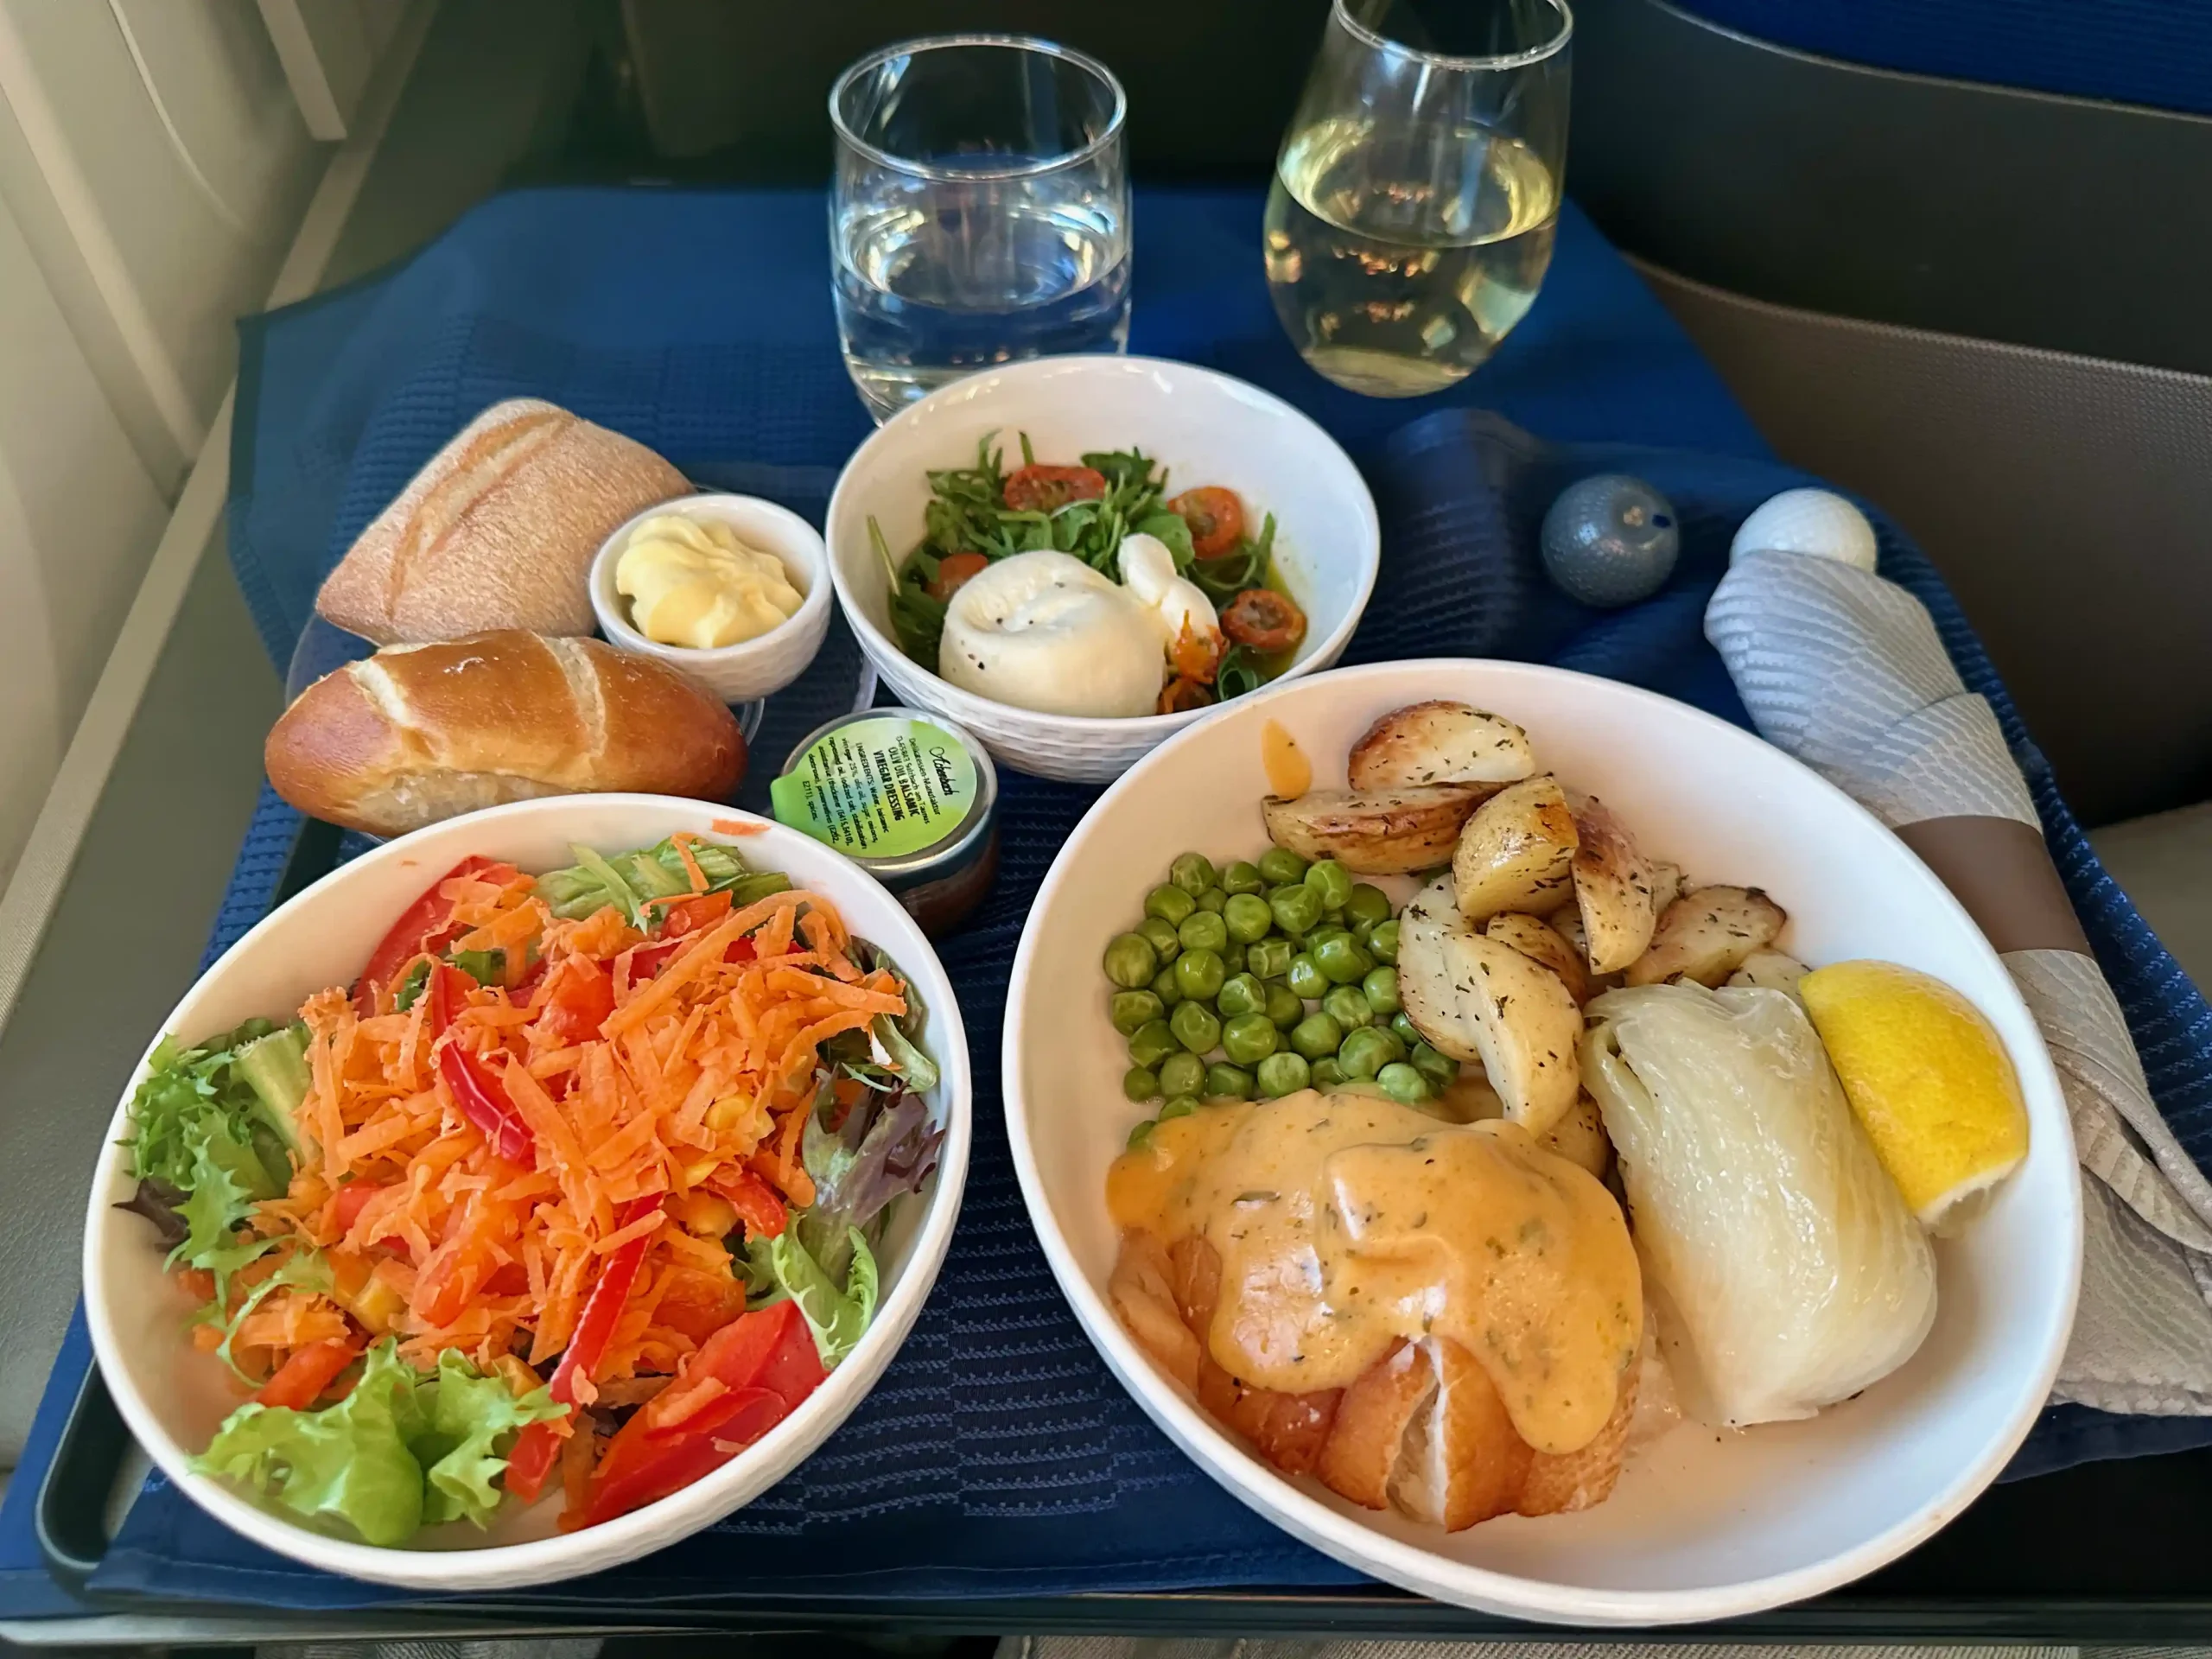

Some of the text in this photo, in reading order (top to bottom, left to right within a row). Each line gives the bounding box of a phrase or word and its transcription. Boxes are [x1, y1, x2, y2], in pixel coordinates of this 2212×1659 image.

[873, 749, 906, 822] VINEGAR DRESSING
[887, 746, 921, 817] OLIV OIL BALSAMIC
[928, 746, 961, 797] Achenbach
[914, 791, 923, 802] am
[918, 801, 931, 825] Taunus
[875, 807, 890, 834] balsamic
